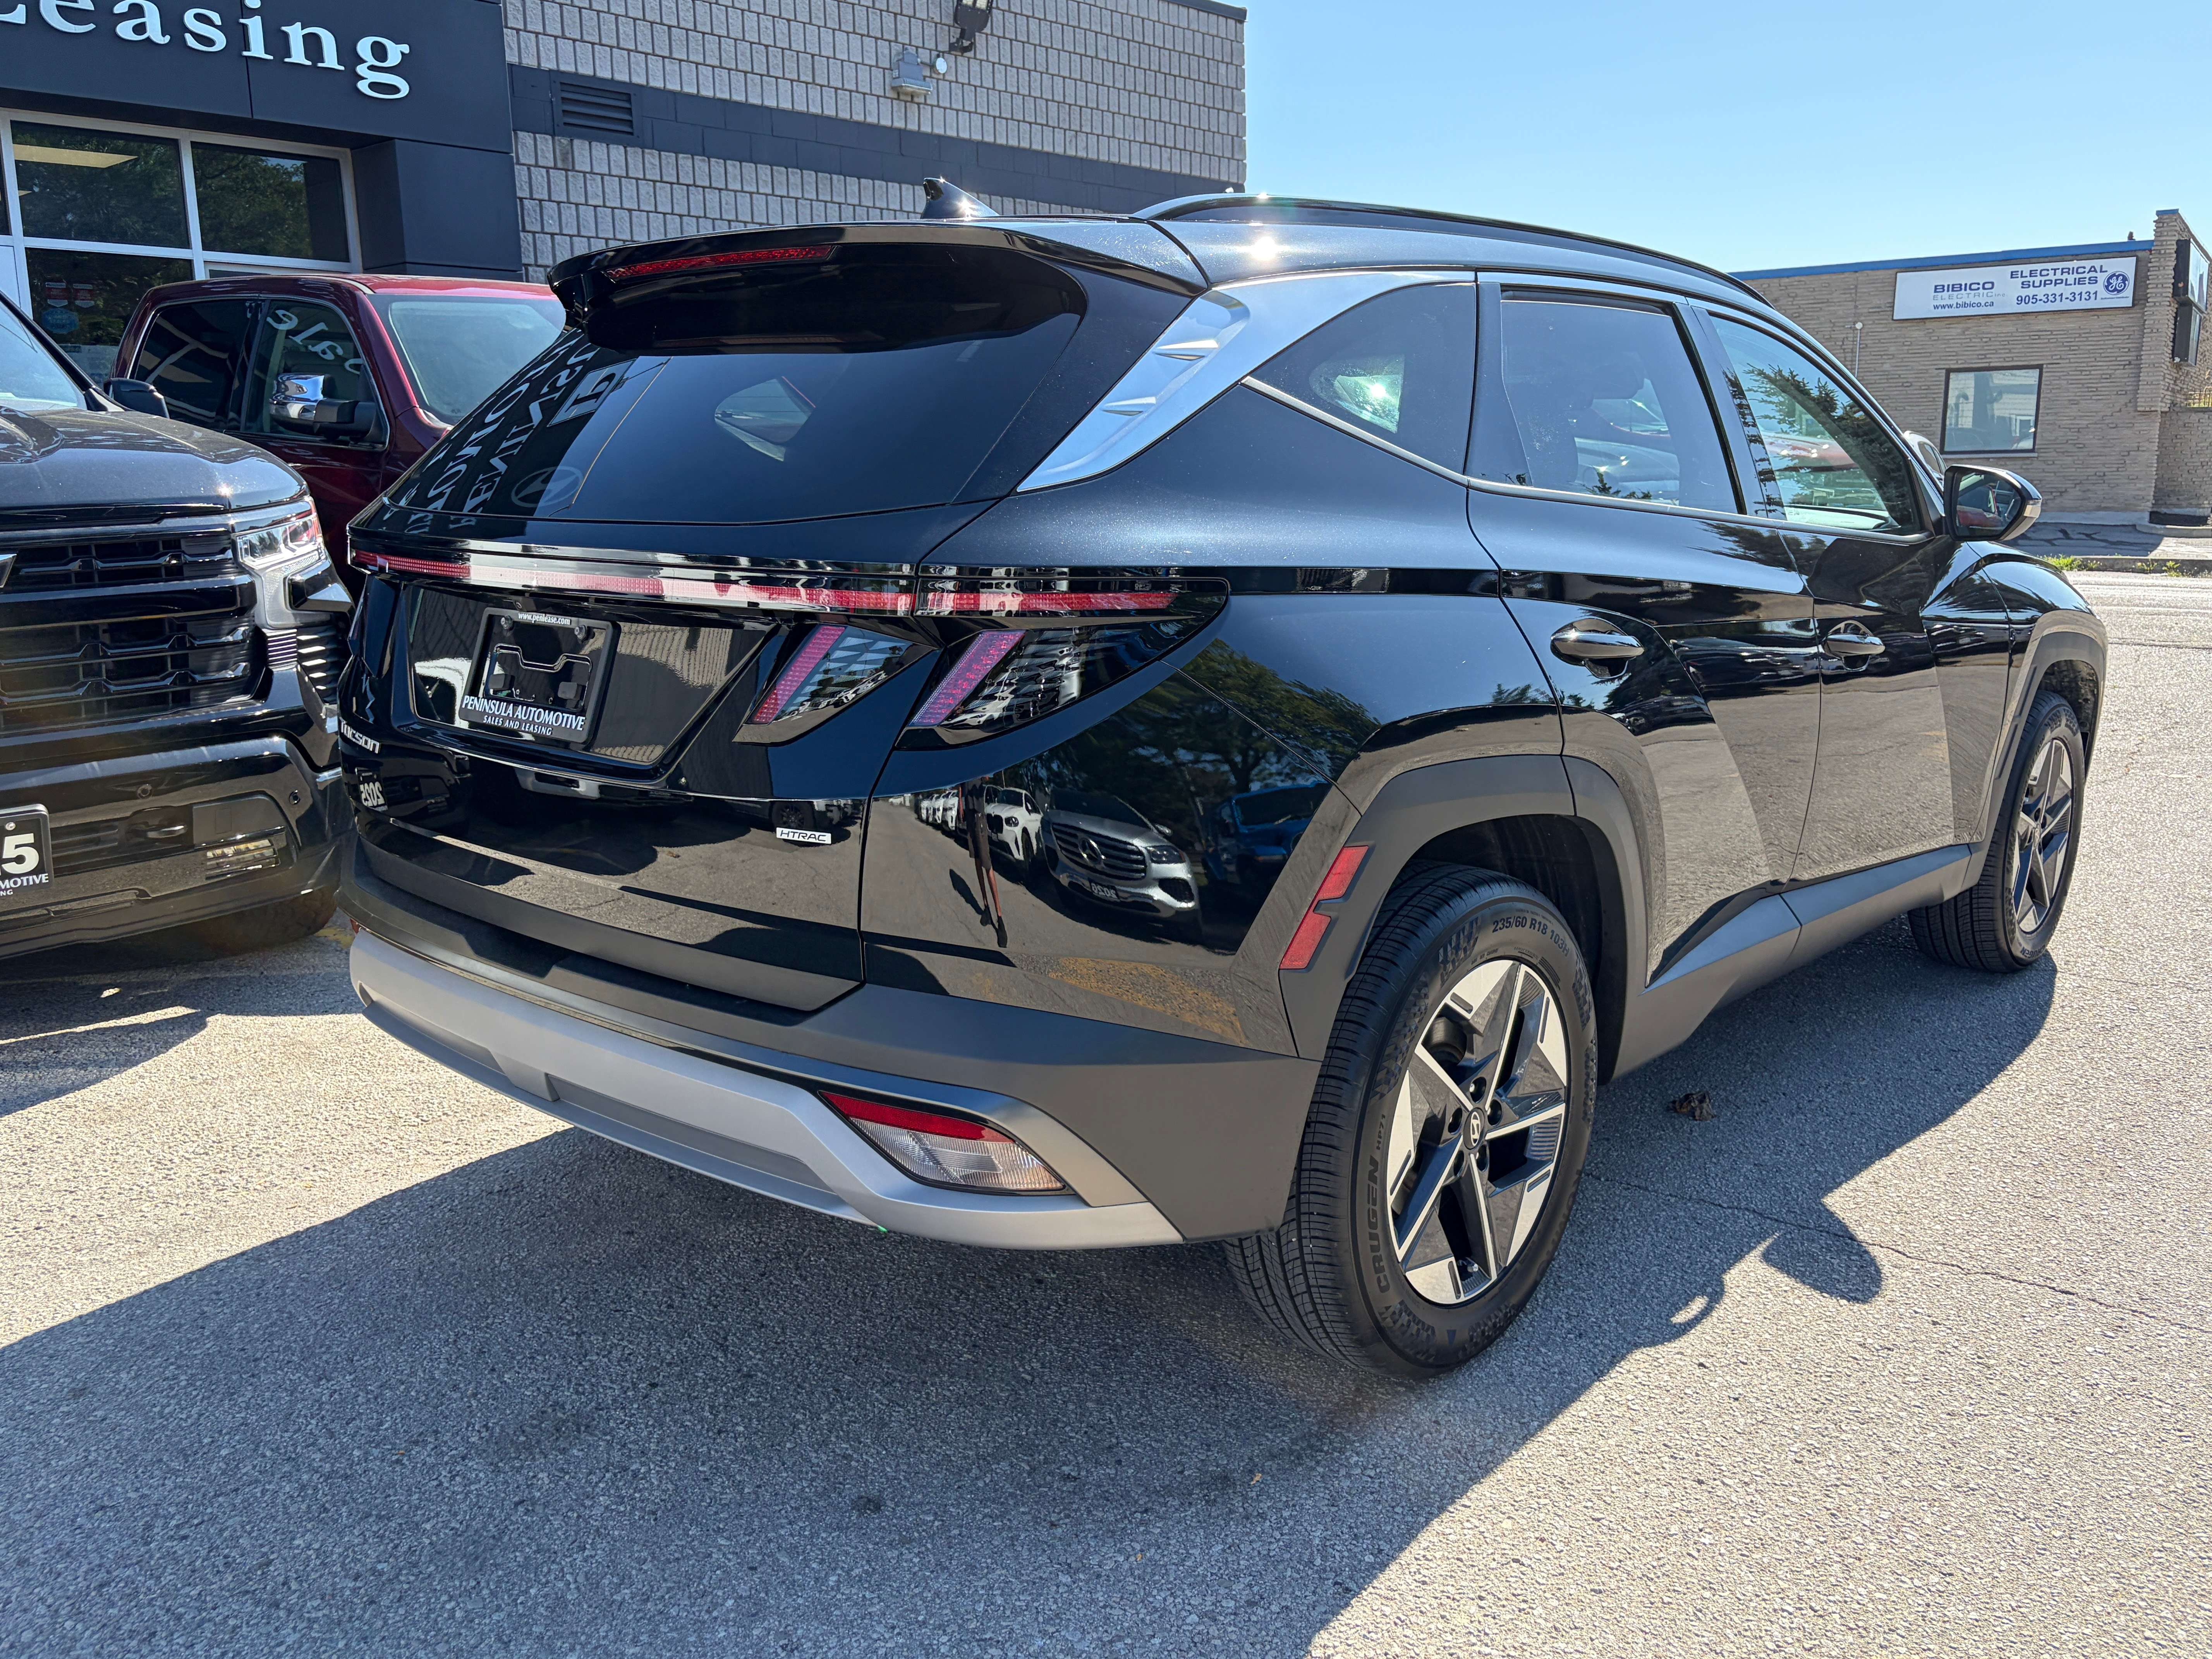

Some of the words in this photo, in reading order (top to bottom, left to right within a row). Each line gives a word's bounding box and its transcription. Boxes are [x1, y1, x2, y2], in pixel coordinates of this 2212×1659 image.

[0, 0, 410, 99] easing
[2010, 265, 2108, 279] ELECTRICAL
[1934, 281, 1995, 293] BIBICO
[2021, 276, 2098, 289] SUPPLIES
[1933, 292, 1993, 301] ELECTRIC
[2016, 290, 2098, 305] 905-331-3131
[1933, 301, 1994, 310] www.bibico.ca
[518, 613, 570, 625] www.penlease.com
[462, 695, 513, 717] PENINSULA
[514, 704, 586, 731] AUTOMOTIVE
[483, 715, 502, 726] SALES
[505, 719, 519, 729] AND
[522, 723, 552, 735] LEASING
[780, 830, 826, 842] HTRAC
[1492, 915, 1527, 933] 235/60
[1528, 917, 1548, 935] R18
[1549, 929, 1570, 957] 103H
[1367, 1155, 1390, 1294] CRUGEN
